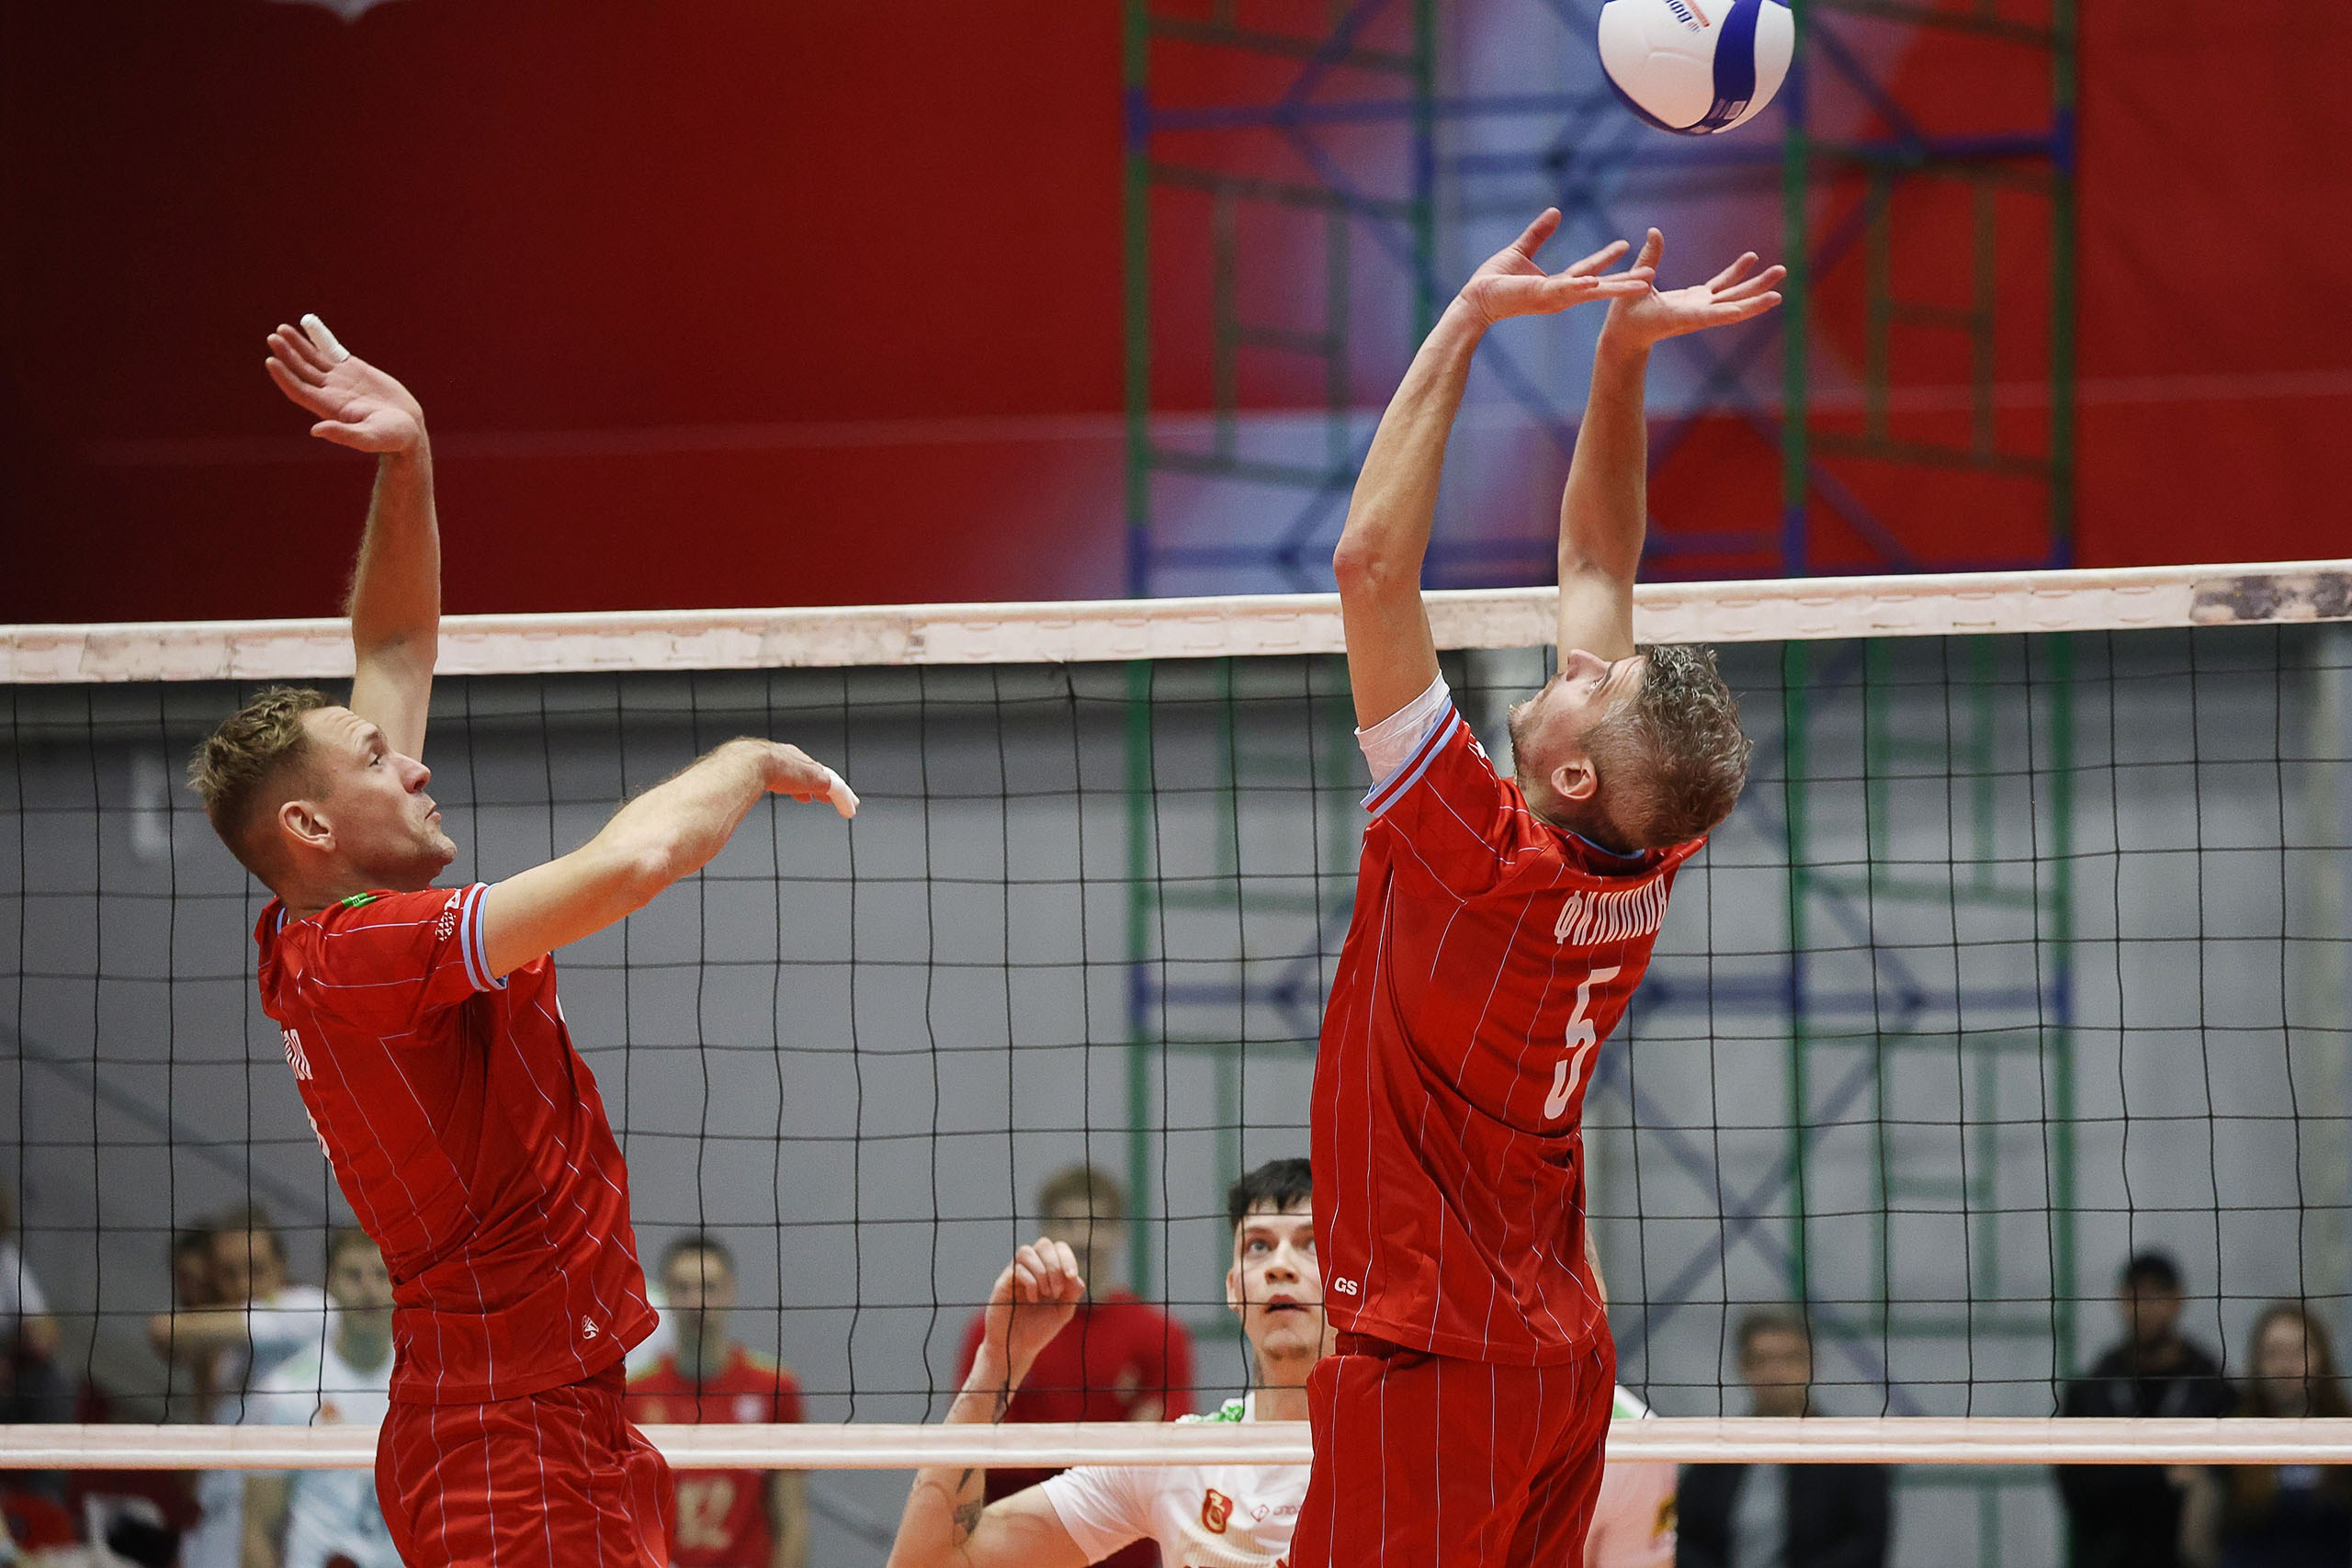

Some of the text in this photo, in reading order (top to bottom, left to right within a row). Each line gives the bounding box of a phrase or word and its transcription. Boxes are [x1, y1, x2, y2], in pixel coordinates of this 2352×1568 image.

[1554, 874, 1668, 946] ФИЛИППОВ
[1544, 965, 1622, 1120] 5
[1334, 1277, 1358, 1296] GS
